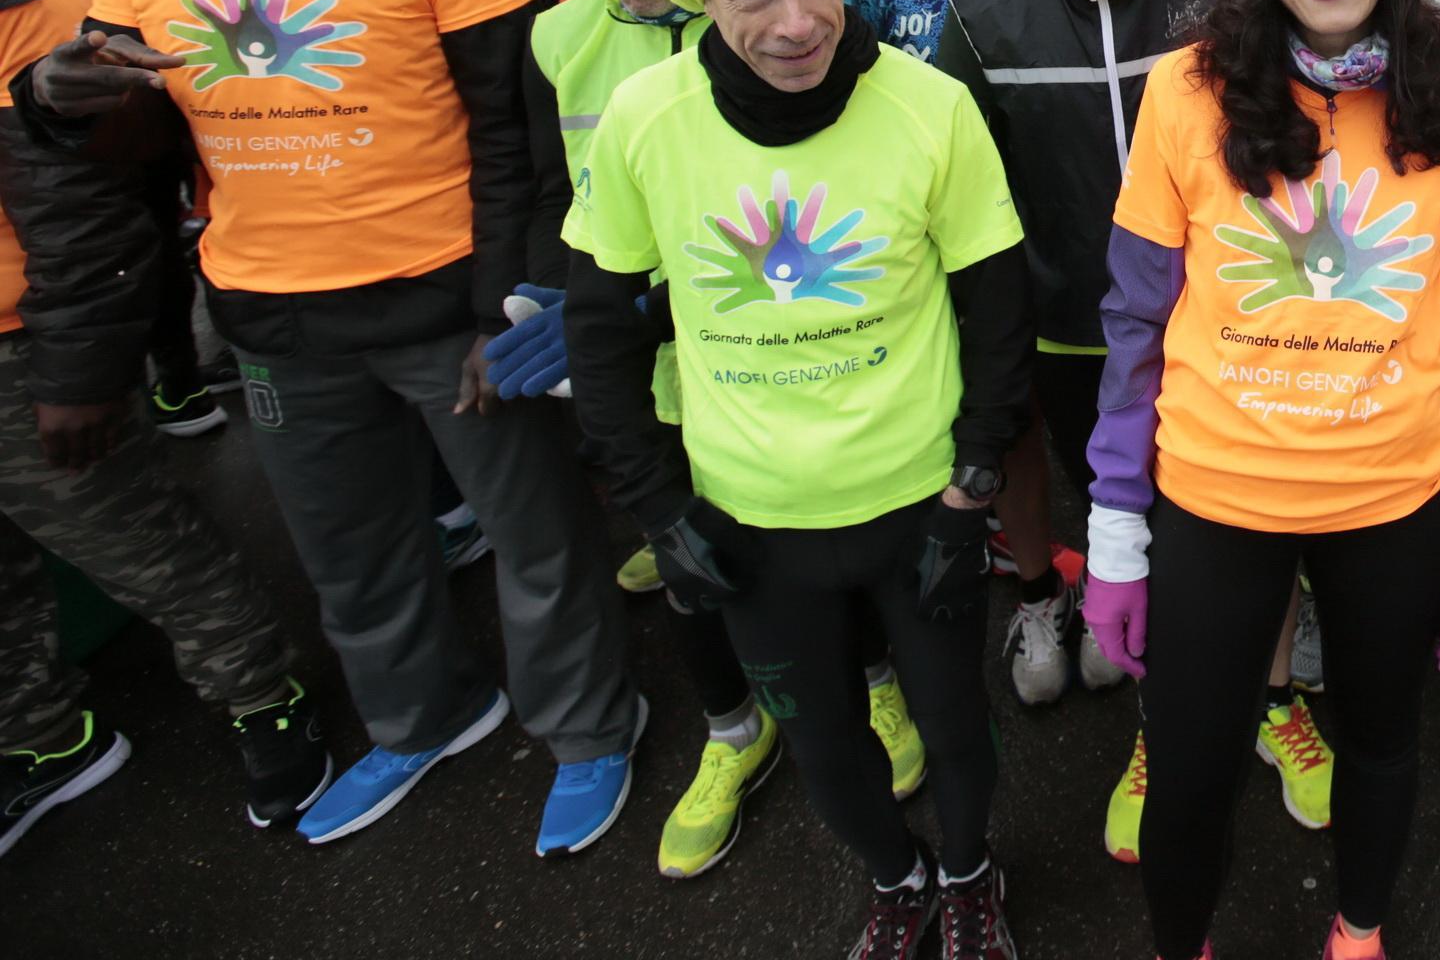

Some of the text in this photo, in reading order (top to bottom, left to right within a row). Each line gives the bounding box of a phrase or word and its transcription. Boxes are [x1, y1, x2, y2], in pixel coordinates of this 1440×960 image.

[229, 107, 262, 120] delle
[268, 106, 327, 120] Malattie
[332, 104, 369, 117] Rare
[248, 132, 343, 152] GENZYME
[304, 153, 344, 177] Life
[699, 315, 884, 346] Giornata delle Malattie Rare
[1220, 326, 1279, 348] Giornata
[1284, 334, 1319, 351] delle
[1323, 337, 1384, 354] Malattie
[713, 357, 860, 385] ANOFI GENZYME
[1237, 391, 1383, 426] Empowering Life
